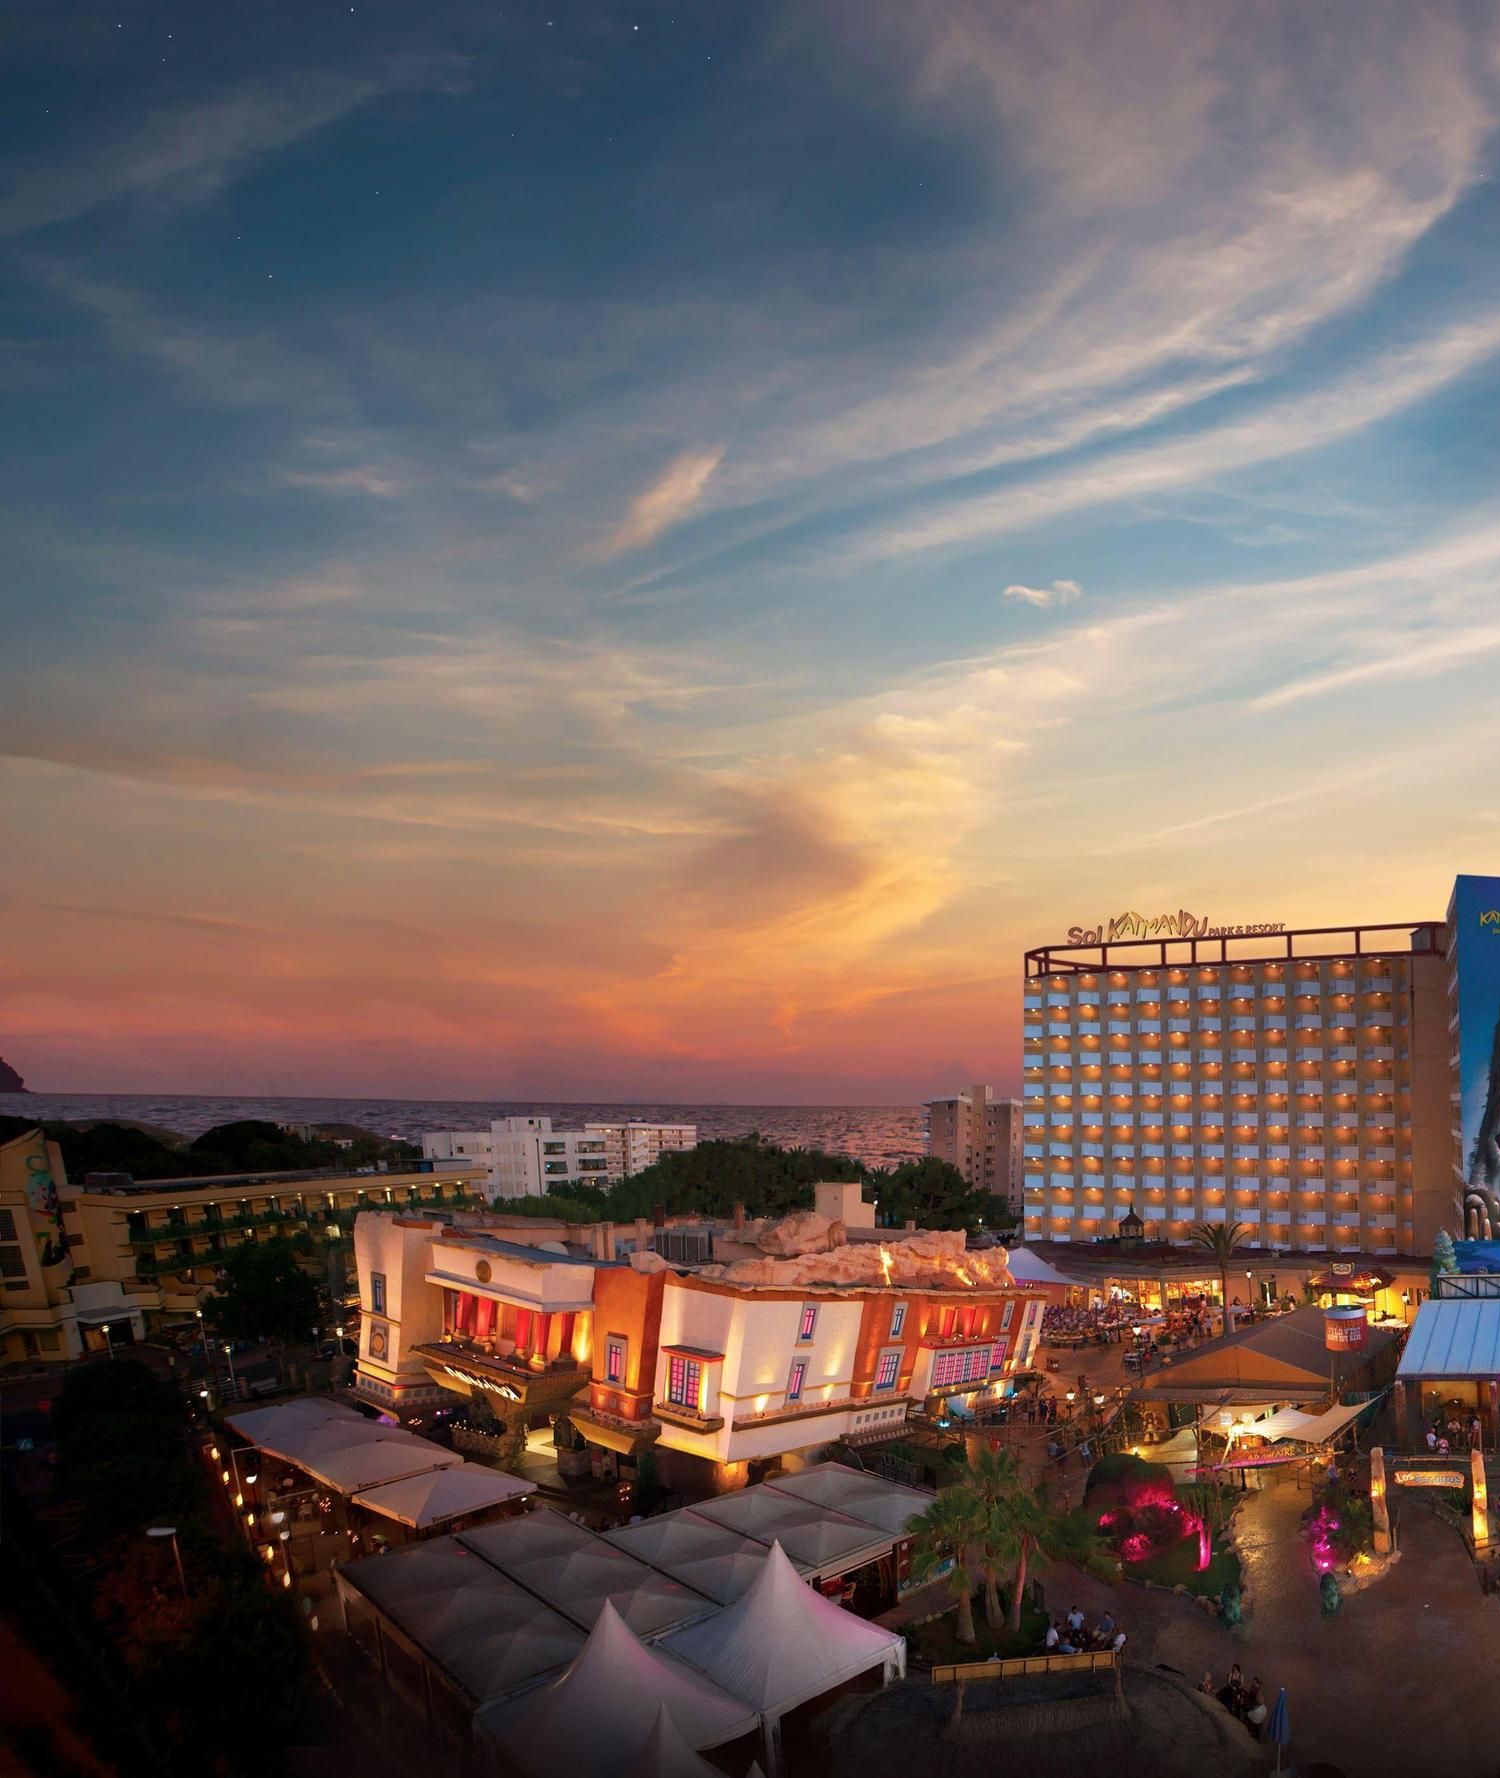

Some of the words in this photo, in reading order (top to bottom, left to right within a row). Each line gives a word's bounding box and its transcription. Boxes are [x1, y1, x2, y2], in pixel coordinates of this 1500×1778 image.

[1067, 925, 1103, 945] Sol
[1107, 909, 1208, 943] KATMANDU
[1208, 927, 1236, 937] PARK
[1244, 922, 1286, 935] RESORT
[1262, 1445, 1295, 1459] THEATRE
